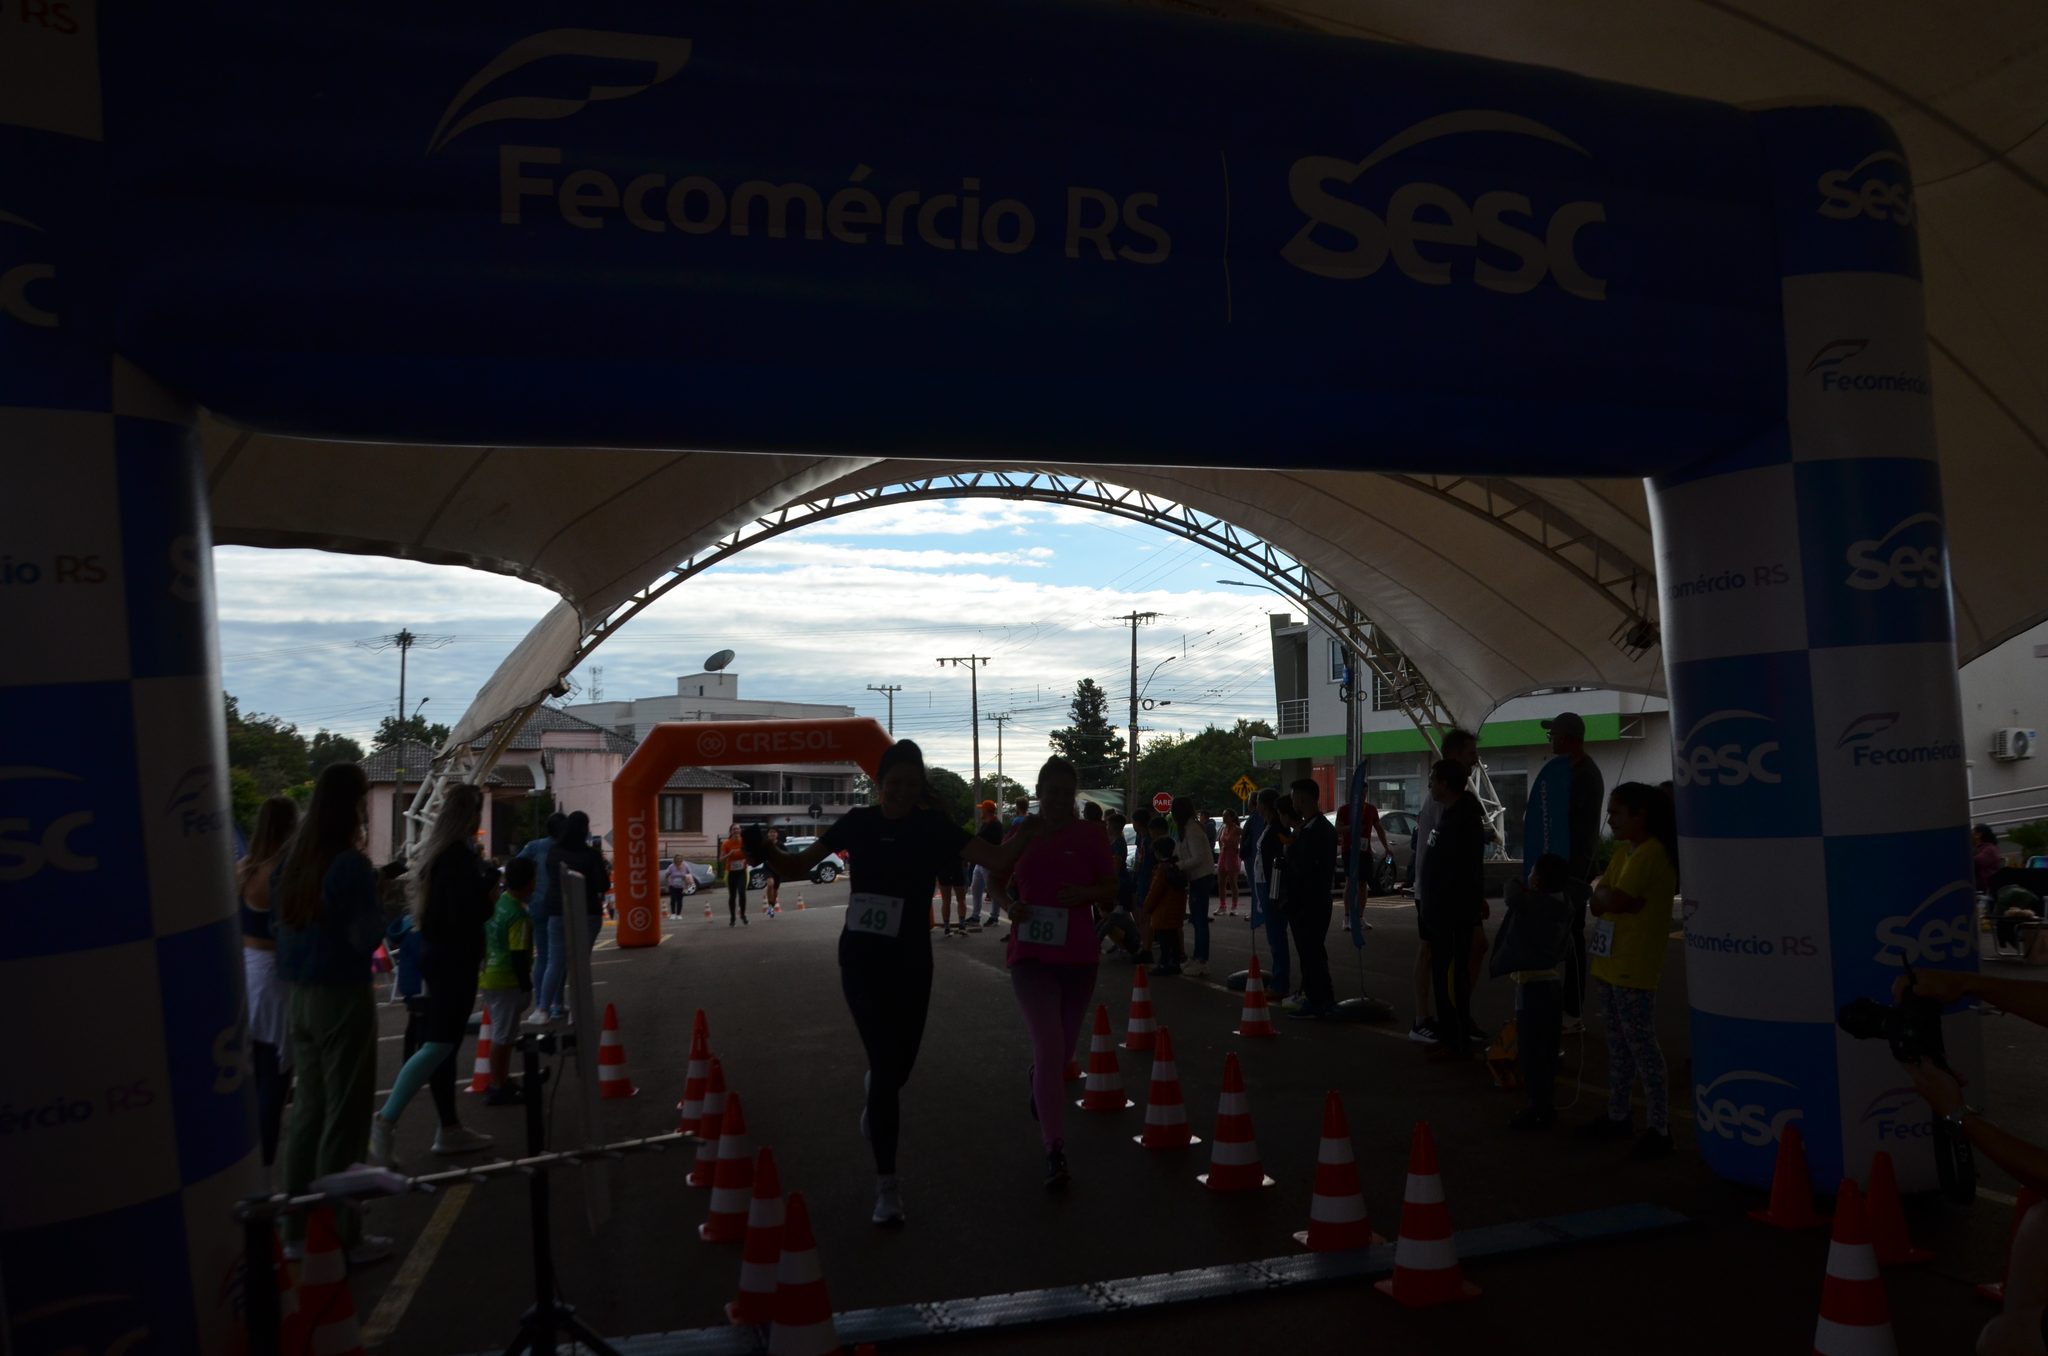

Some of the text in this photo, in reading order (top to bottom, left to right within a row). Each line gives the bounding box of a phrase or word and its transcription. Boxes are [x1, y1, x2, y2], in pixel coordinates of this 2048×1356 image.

[499, 144, 1172, 264] Fecomércio RS
[1280, 112, 1608, 301] Sesc
[55, 554, 107, 584] RS
[1753, 564, 1790, 587] RS
[736, 729, 842, 753] CRESOL
[627, 808, 647, 899] CRESOL
[860, 908, 887, 931] 49
[1029, 920, 1054, 942] 68
[1873, 896, 1975, 967] Ses
[1686, 926, 1818, 957] ecomércio RS
[105, 1078, 154, 1116] RS
